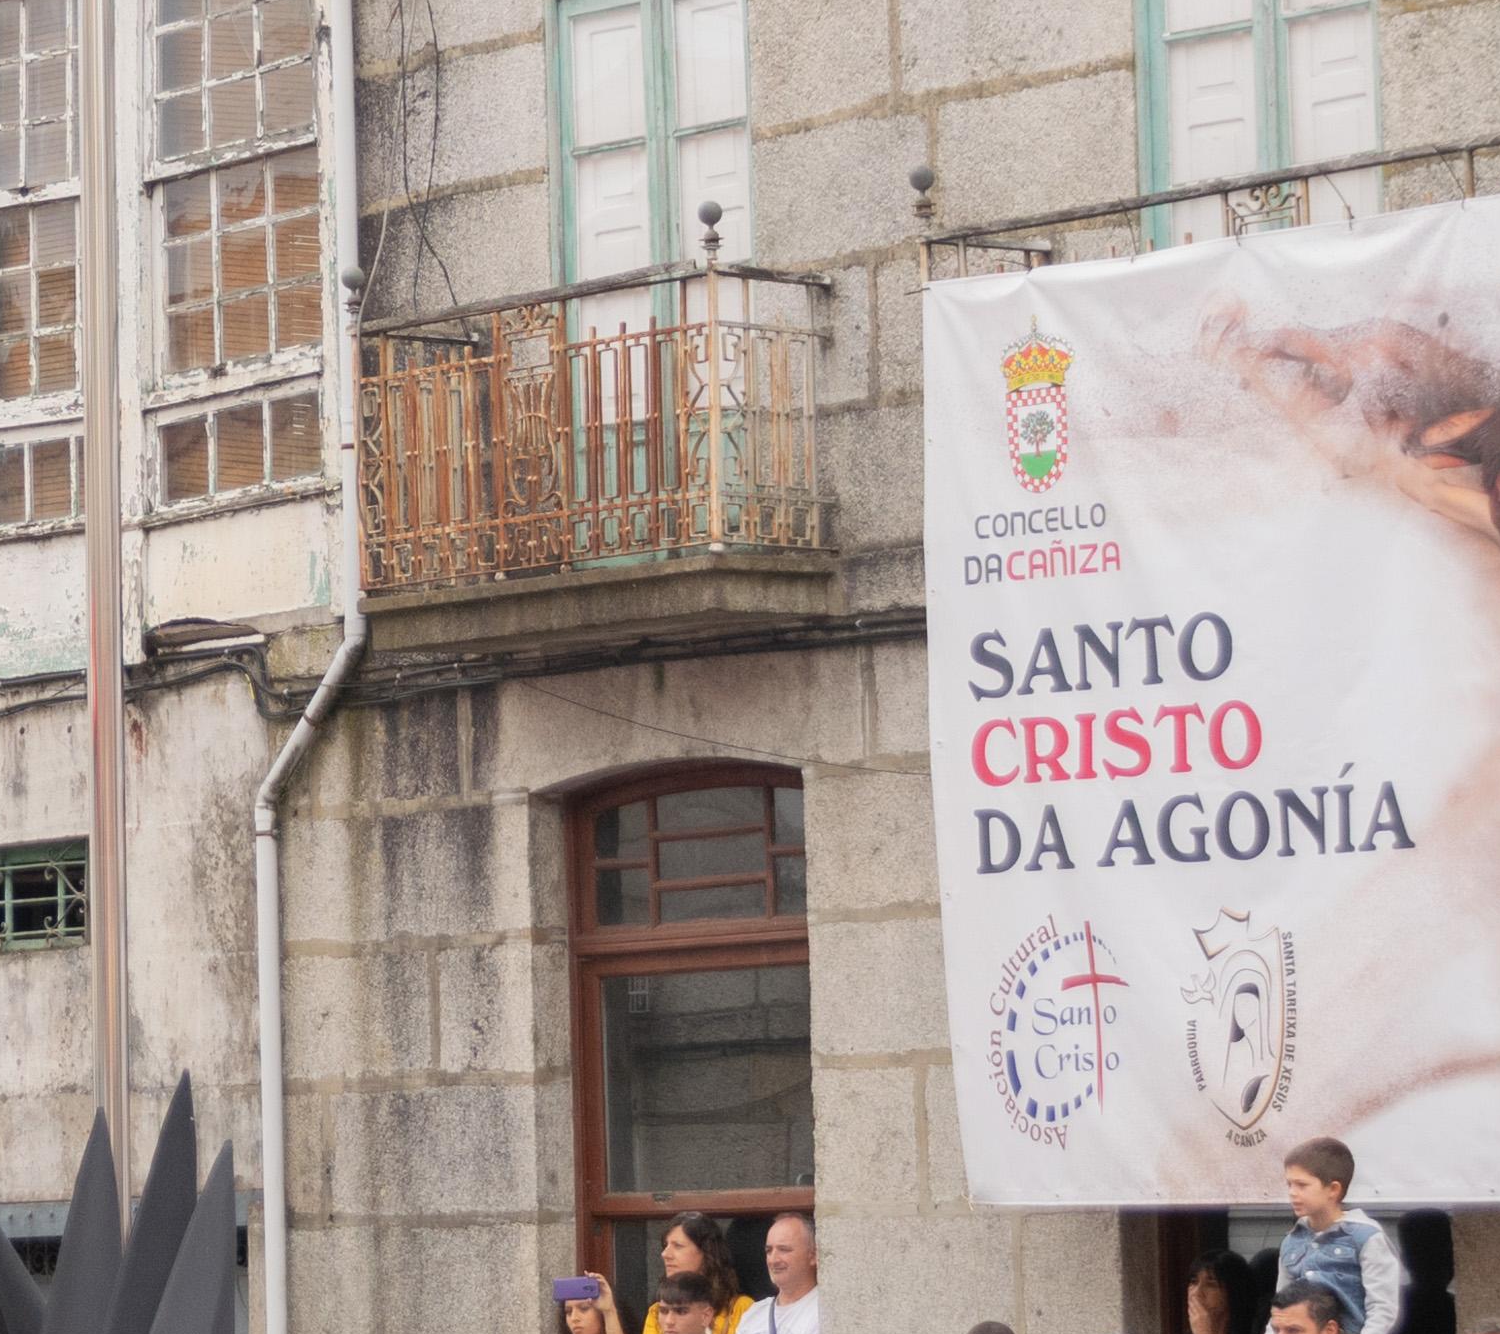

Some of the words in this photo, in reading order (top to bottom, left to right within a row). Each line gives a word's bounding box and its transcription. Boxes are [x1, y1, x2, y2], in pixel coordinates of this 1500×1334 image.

[974, 502, 1106, 539] CONCELLO
[968, 611, 1233, 702] SANTO
[971, 699, 1263, 787] CRISTO
[974, 804, 1075, 875] DA
[1097, 762, 1416, 868] AGONÍA
[989, 913, 1058, 1017] Cultural
[1281, 931, 1295, 980] SANTA
[1283, 1042, 1295, 1062] DE
[1284, 981, 1297, 1039] TAREIXA
[986, 1029, 1068, 1151] Asociación
